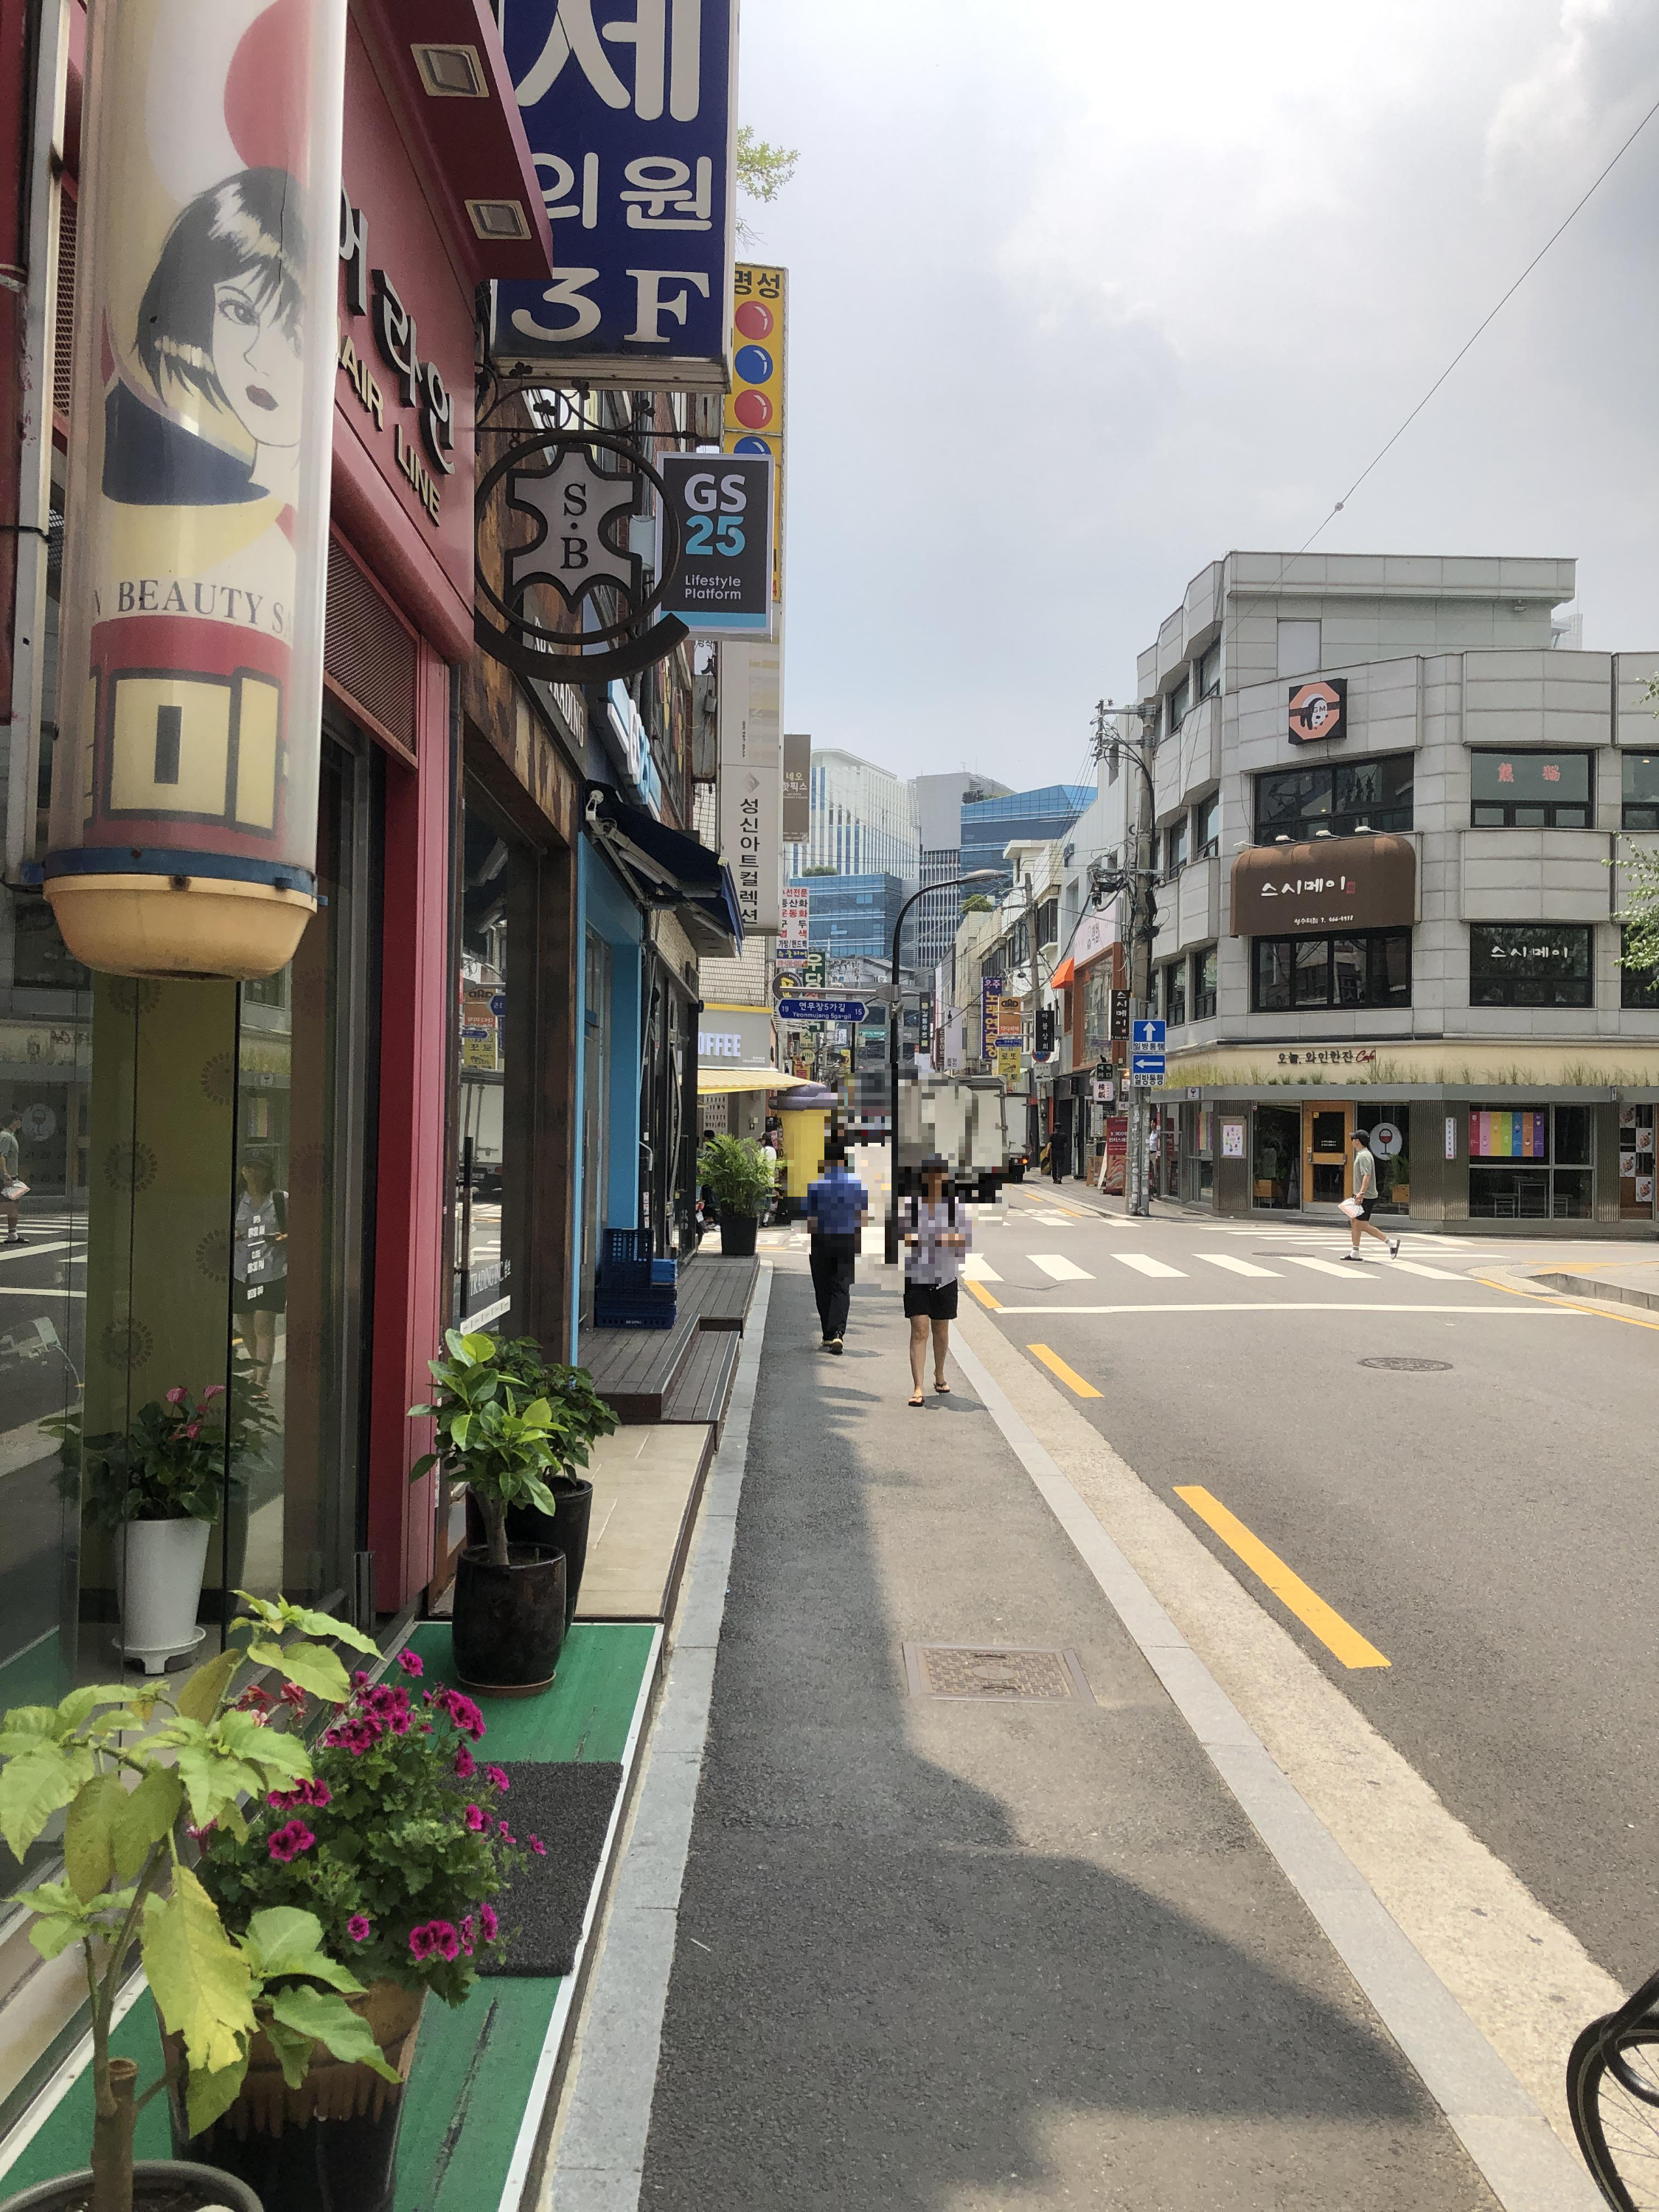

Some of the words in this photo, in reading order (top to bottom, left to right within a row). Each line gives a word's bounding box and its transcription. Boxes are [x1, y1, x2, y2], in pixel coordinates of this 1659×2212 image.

[532, 152, 712, 231] 의원
[735, 273, 781, 299] 명성
[338, 317, 384, 432] AIR
[397, 424, 441, 528] LINE
[684, 473, 747, 512] GS
[686, 515, 745, 556] 25
[684, 574, 742, 589] Lifestyle
[684, 588, 742, 600] Platform
[116, 580, 264, 625] BEAUTY
[786, 772, 804, 782] 네오
[739, 798, 760, 925] 성신아트컬렉션
[1261, 876, 1346, 897] 스시메이
[1491, 946, 1568, 959] 스시메이
[799, 1001, 846, 1012] 연무장5가길
[1115, 991, 1127, 1027] 스시메이
[698, 1032, 741, 1057] OFFEE
[1135, 1043, 1165, 1051] 일방통행
[1135, 1074, 1164, 1085] 일방통행
